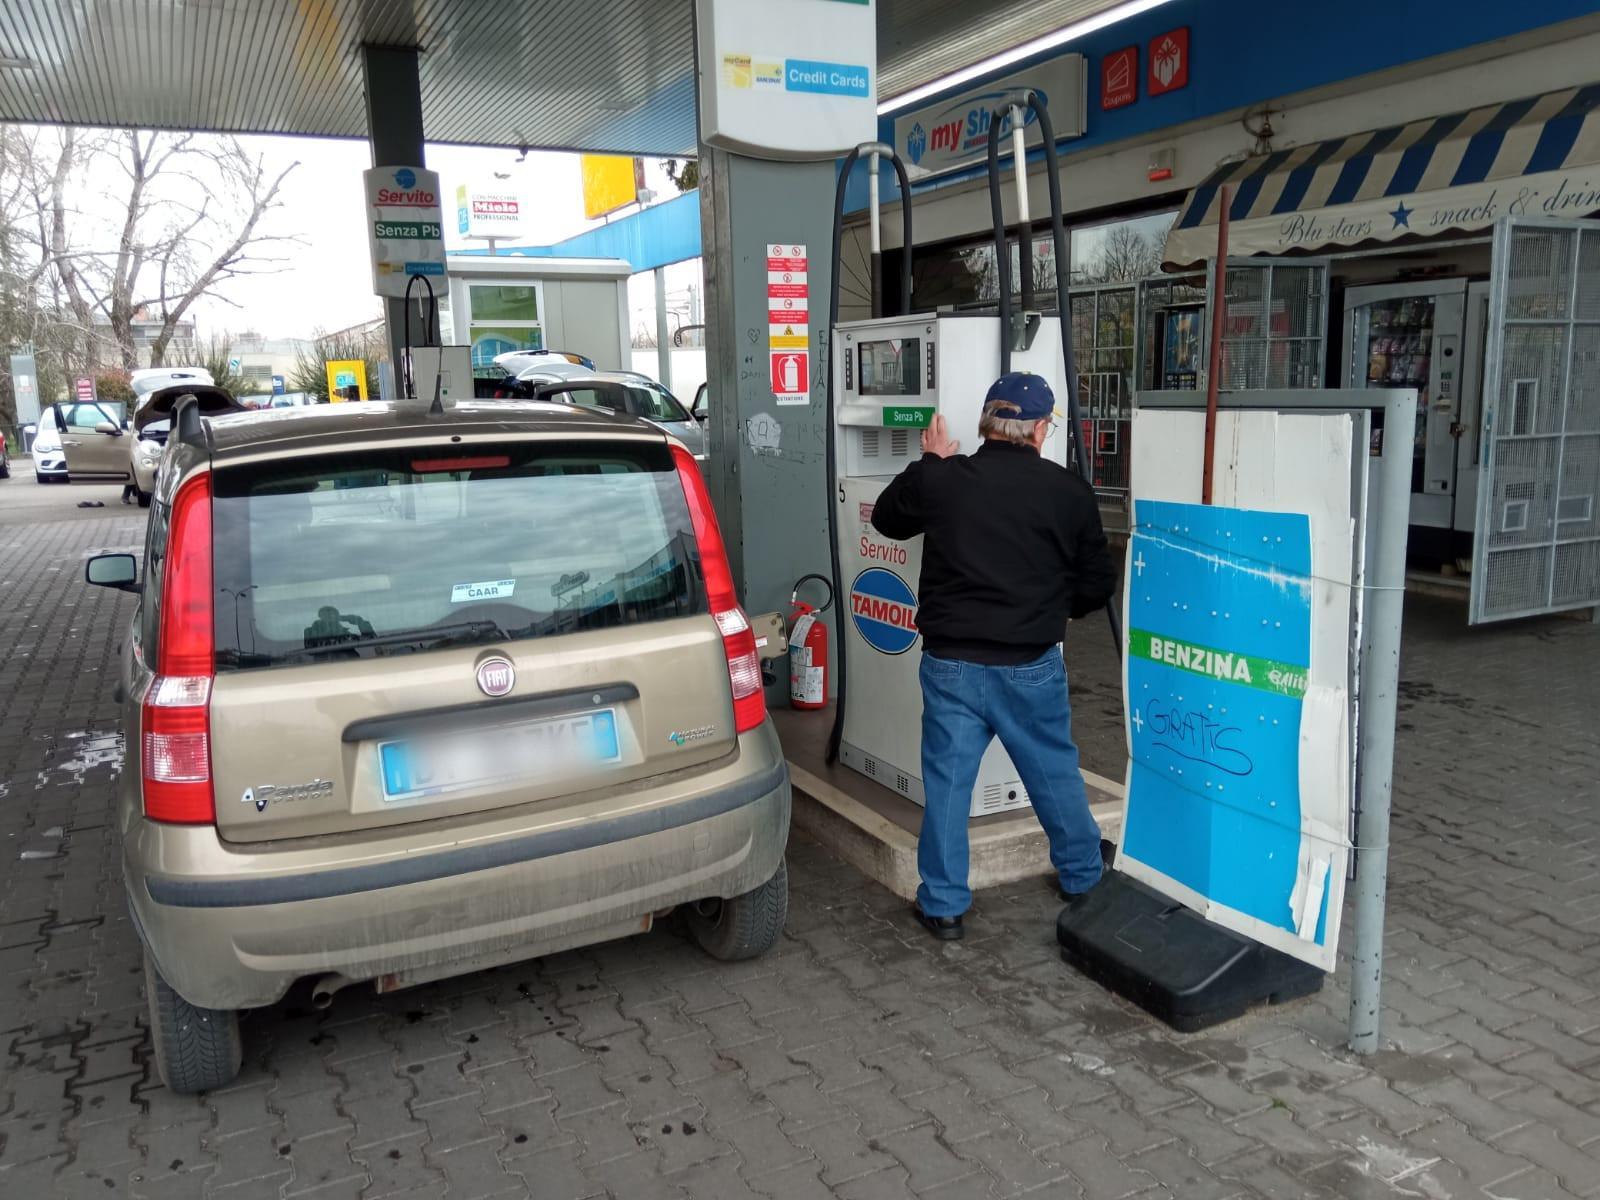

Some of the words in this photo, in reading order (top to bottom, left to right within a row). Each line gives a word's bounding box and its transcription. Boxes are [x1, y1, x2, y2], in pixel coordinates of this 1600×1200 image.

[789, 68, 828, 85] Credit
[830, 72, 866, 89] Cards
[1103, 94, 1131, 106] Coupons
[930, 119, 964, 151] my
[967, 106, 1013, 137] Shp
[378, 188, 434, 204] Servito
[1278, 215, 1322, 246] Blu
[1327, 216, 1373, 238] stars
[1430, 189, 1497, 227] snack
[1509, 186, 1539, 216] &
[375, 223, 418, 237] Senza
[422, 225, 440, 237] Pb
[894, 410, 913, 422] Senza
[914, 411, 924, 421] Pb
[860, 536, 907, 565] Servito
[468, 586, 499, 598] CAAR
[851, 594, 918, 630] TAMOIL
[1150, 637, 1252, 683] BENZINA
[485, 668, 508, 688] FIAT
[1146, 698, 1253, 775] GRATIS
[256, 779, 334, 800] Panda
